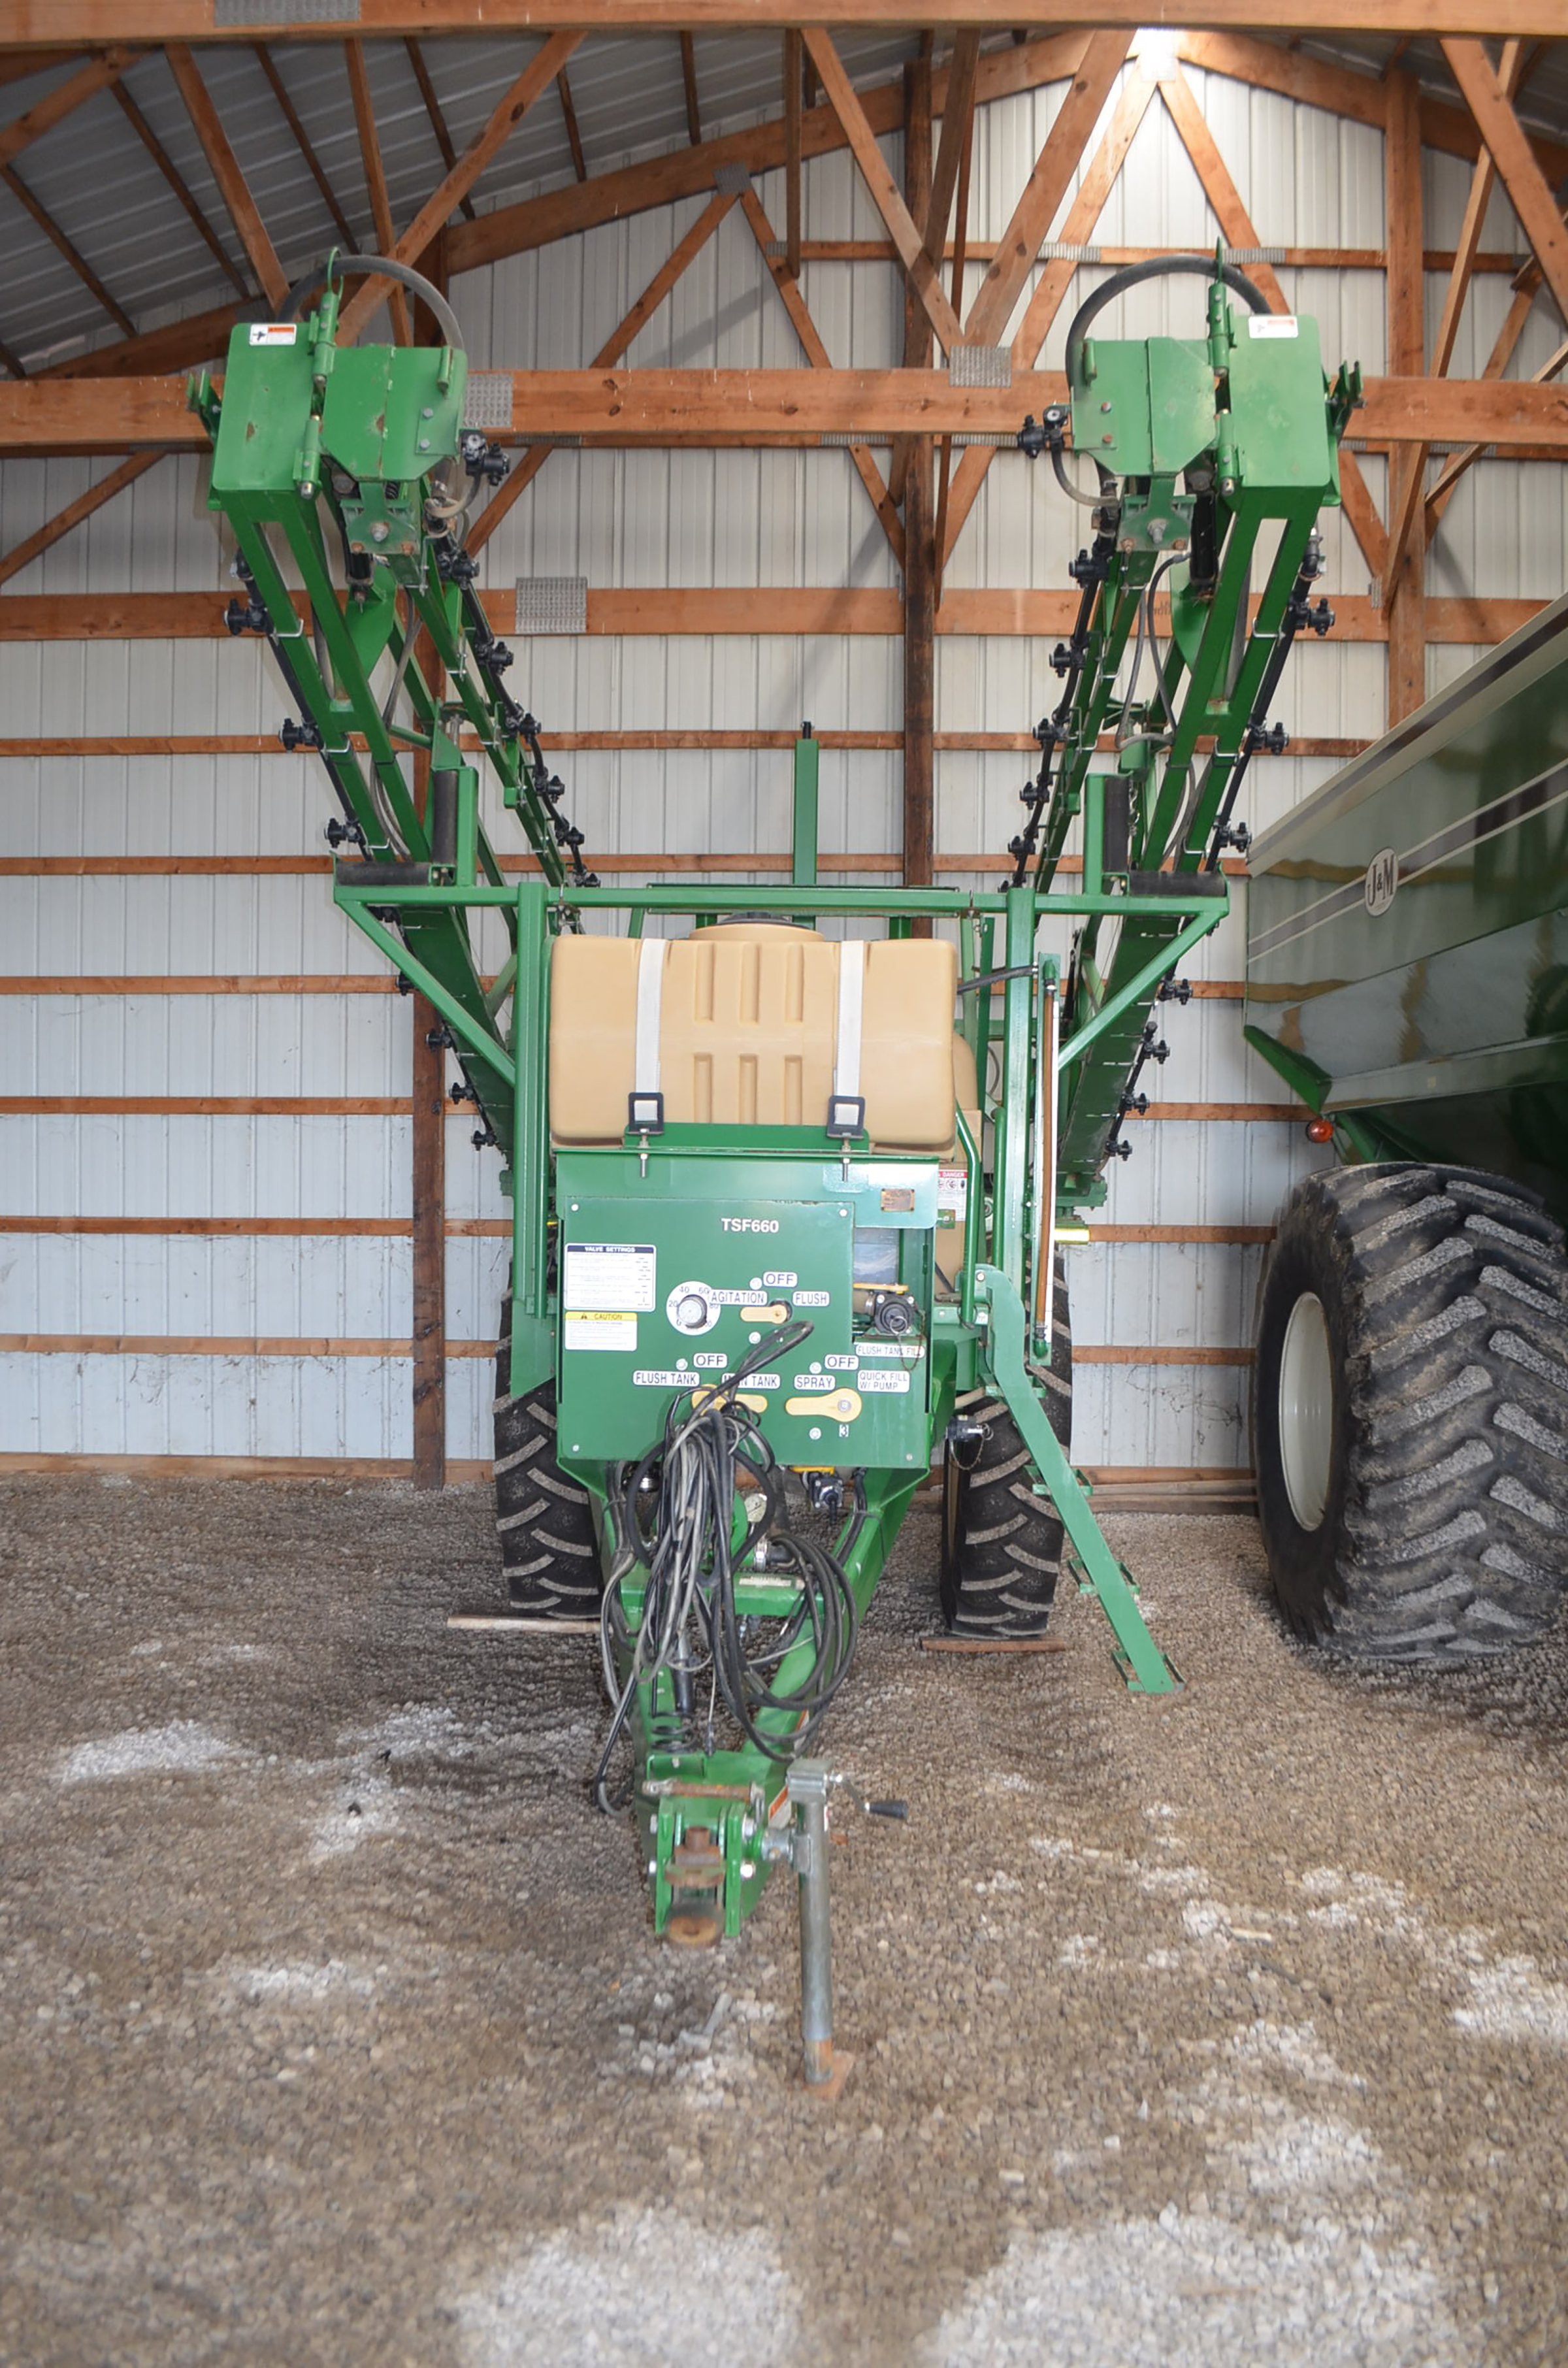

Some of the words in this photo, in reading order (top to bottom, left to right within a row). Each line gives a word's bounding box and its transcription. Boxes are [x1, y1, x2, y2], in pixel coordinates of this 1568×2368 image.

[1367, 854, 1394, 906] J&M
[721, 1218, 779, 1233] TSF660
[766, 1274, 794, 1285] OFF
[711, 1291, 764, 1304] AGITATION
[795, 1293, 828, 1304] FLUSH
[594, 1313, 622, 1321] CAUTION
[858, 1346, 882, 1355] FLUSH
[696, 1355, 724, 1366] OFF
[827, 1356, 856, 1368] OFF
[636, 1372, 666, 1384] FLUSH
[671, 1373, 696, 1385] TANK
[751, 1375, 777, 1387] TANK
[796, 1376, 833, 1389] SPRAY
[860, 1372, 887, 1381] QUICK
[890, 1373, 907, 1382] FILL
[875, 1381, 898, 1390] PUMP
[841, 1425, 847, 1436] 3
